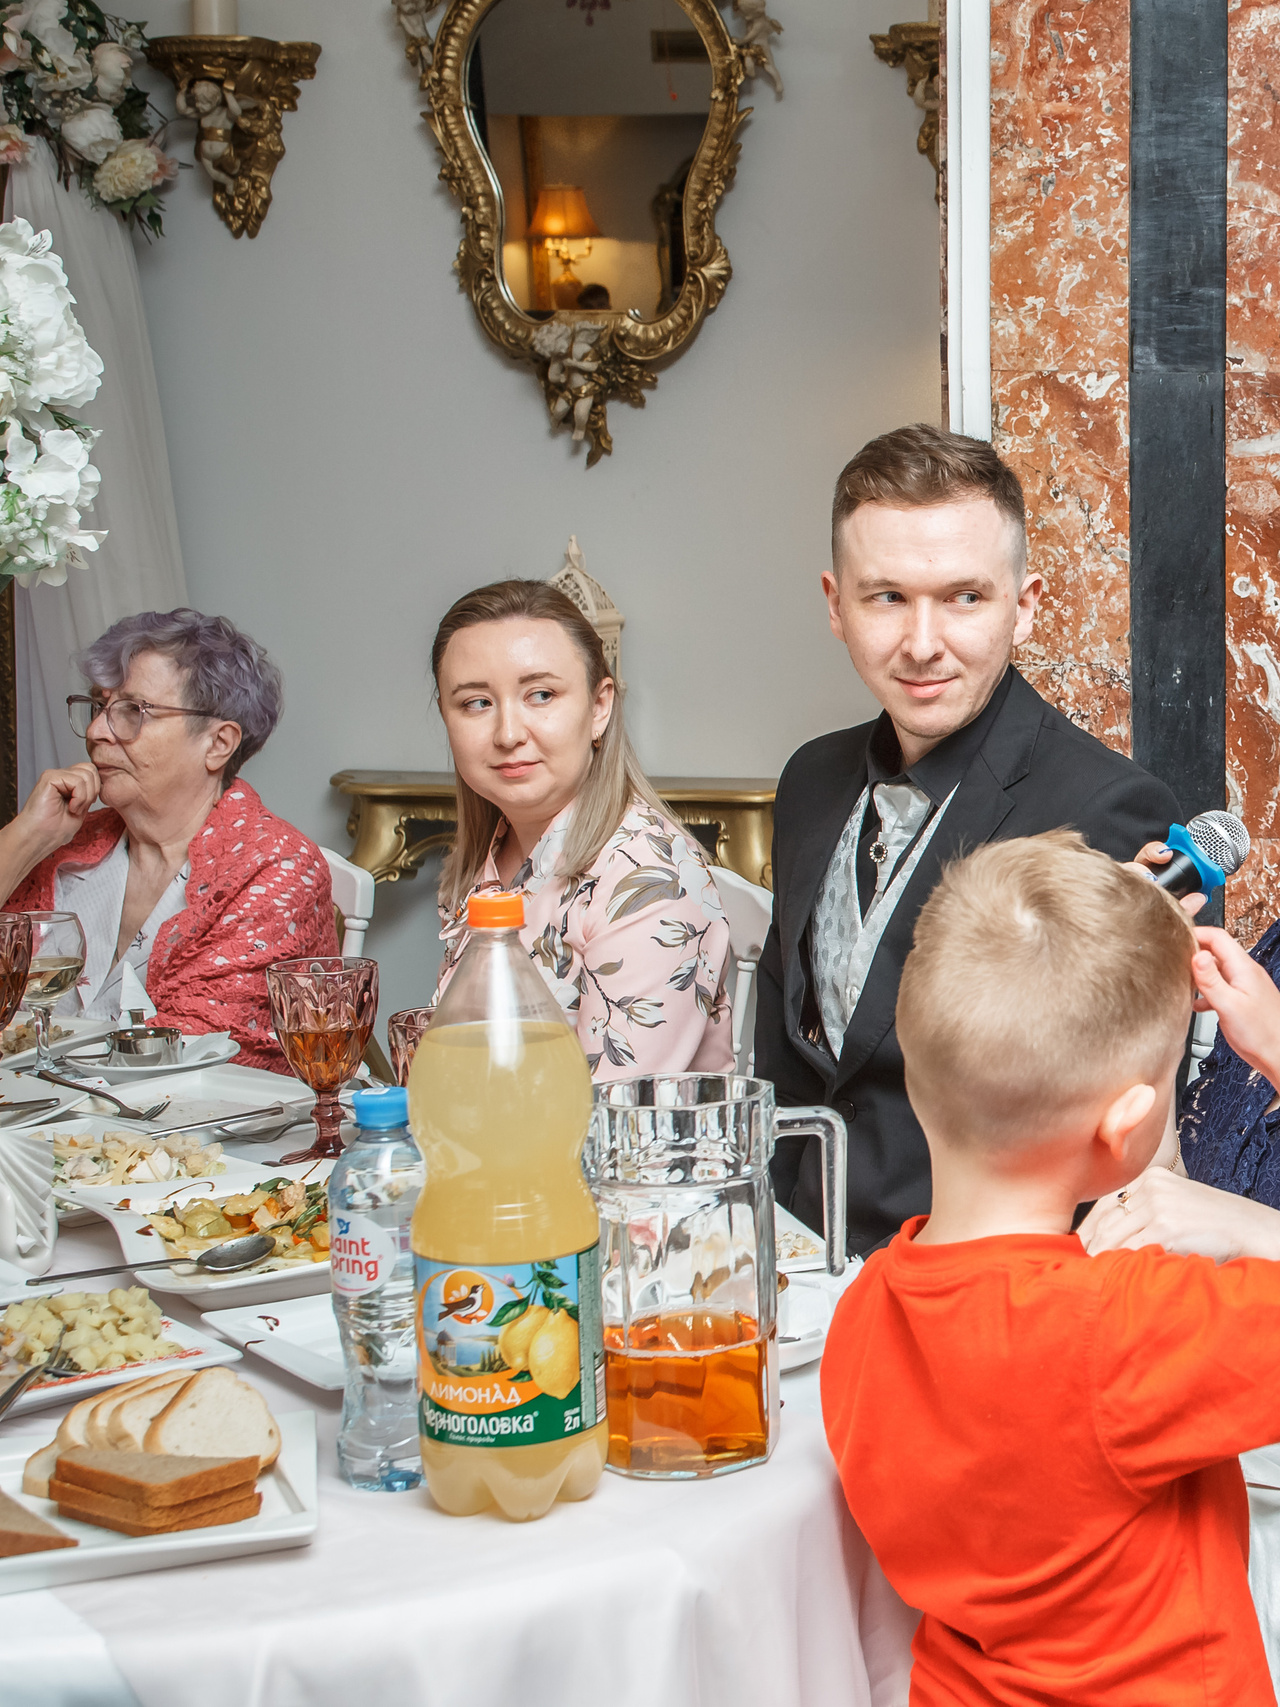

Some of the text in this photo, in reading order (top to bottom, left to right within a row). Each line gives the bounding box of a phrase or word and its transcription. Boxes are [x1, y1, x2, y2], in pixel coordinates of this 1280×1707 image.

[332, 1254, 379, 1281] pring
[423, 1398, 534, 1435] Черноголовка
[564, 1415, 580, 1432] 2л
